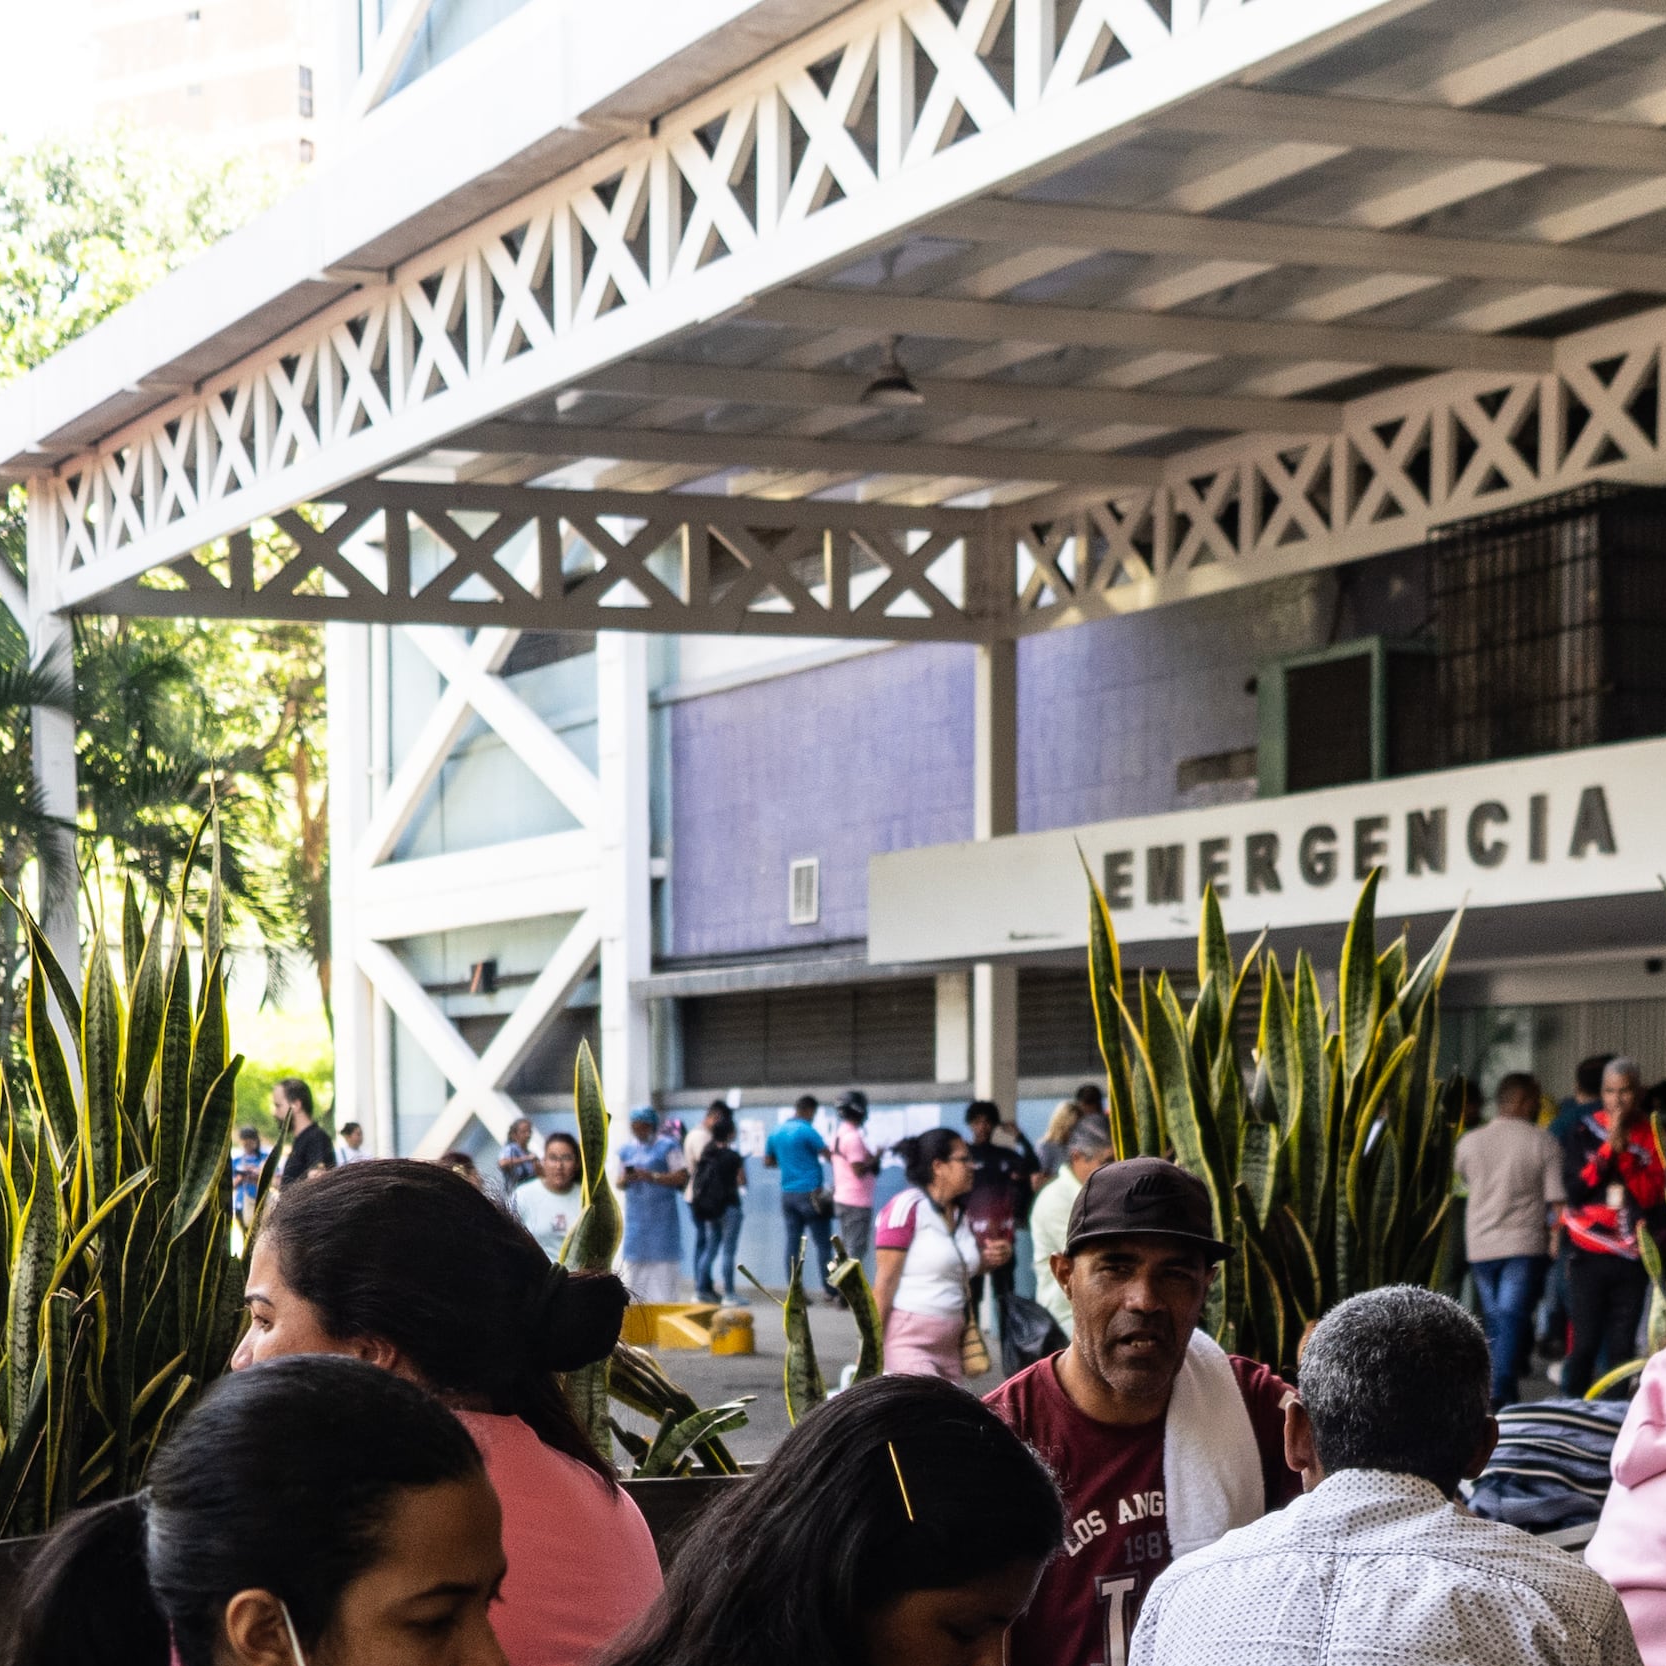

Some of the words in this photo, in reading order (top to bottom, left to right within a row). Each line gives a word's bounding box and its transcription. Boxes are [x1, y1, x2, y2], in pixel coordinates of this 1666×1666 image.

[1102, 785, 1619, 910] EMERGENCIA
[1064, 1509, 1108, 1557] LOS
[1124, 1529, 1170, 1565] 198
